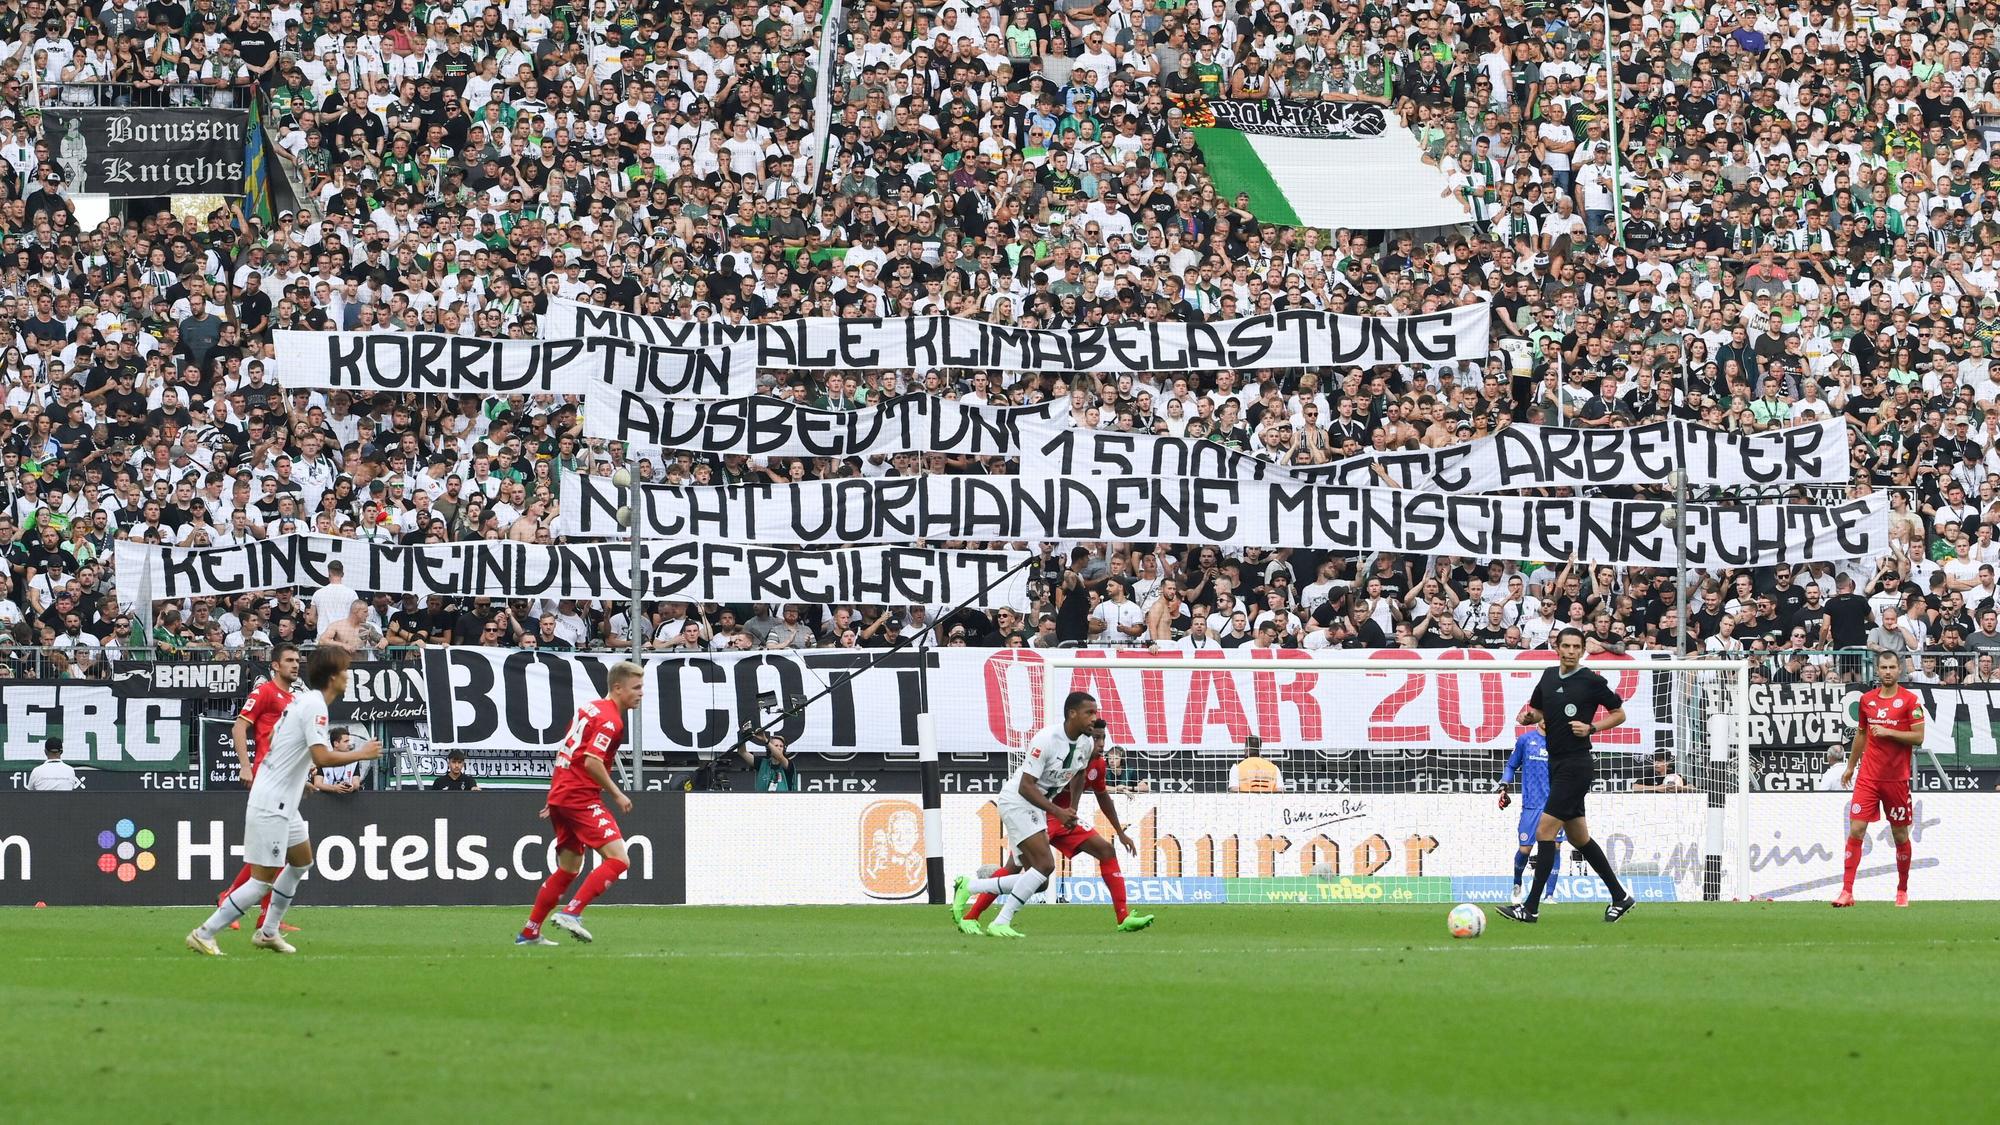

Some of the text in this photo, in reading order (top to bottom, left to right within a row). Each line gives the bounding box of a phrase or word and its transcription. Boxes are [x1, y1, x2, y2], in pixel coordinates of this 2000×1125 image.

[106, 115, 240, 147] Borussen
[101, 157, 243, 186] Knights
[328, 334, 729, 396] KORRUPTION
[904, 309, 1457, 371] KLIMABELASTUNG
[1496, 420, 1822, 486] ARBEITER
[788, 476, 1239, 542] VORHANDENE
[1269, 483, 1872, 565] MENSCHENRECHTE
[162, 534, 1008, 607] KEINE MEINUNGSFREIHEIT
[156, 664, 241, 688] BANDA
[1890, 806, 1906, 821] 42
